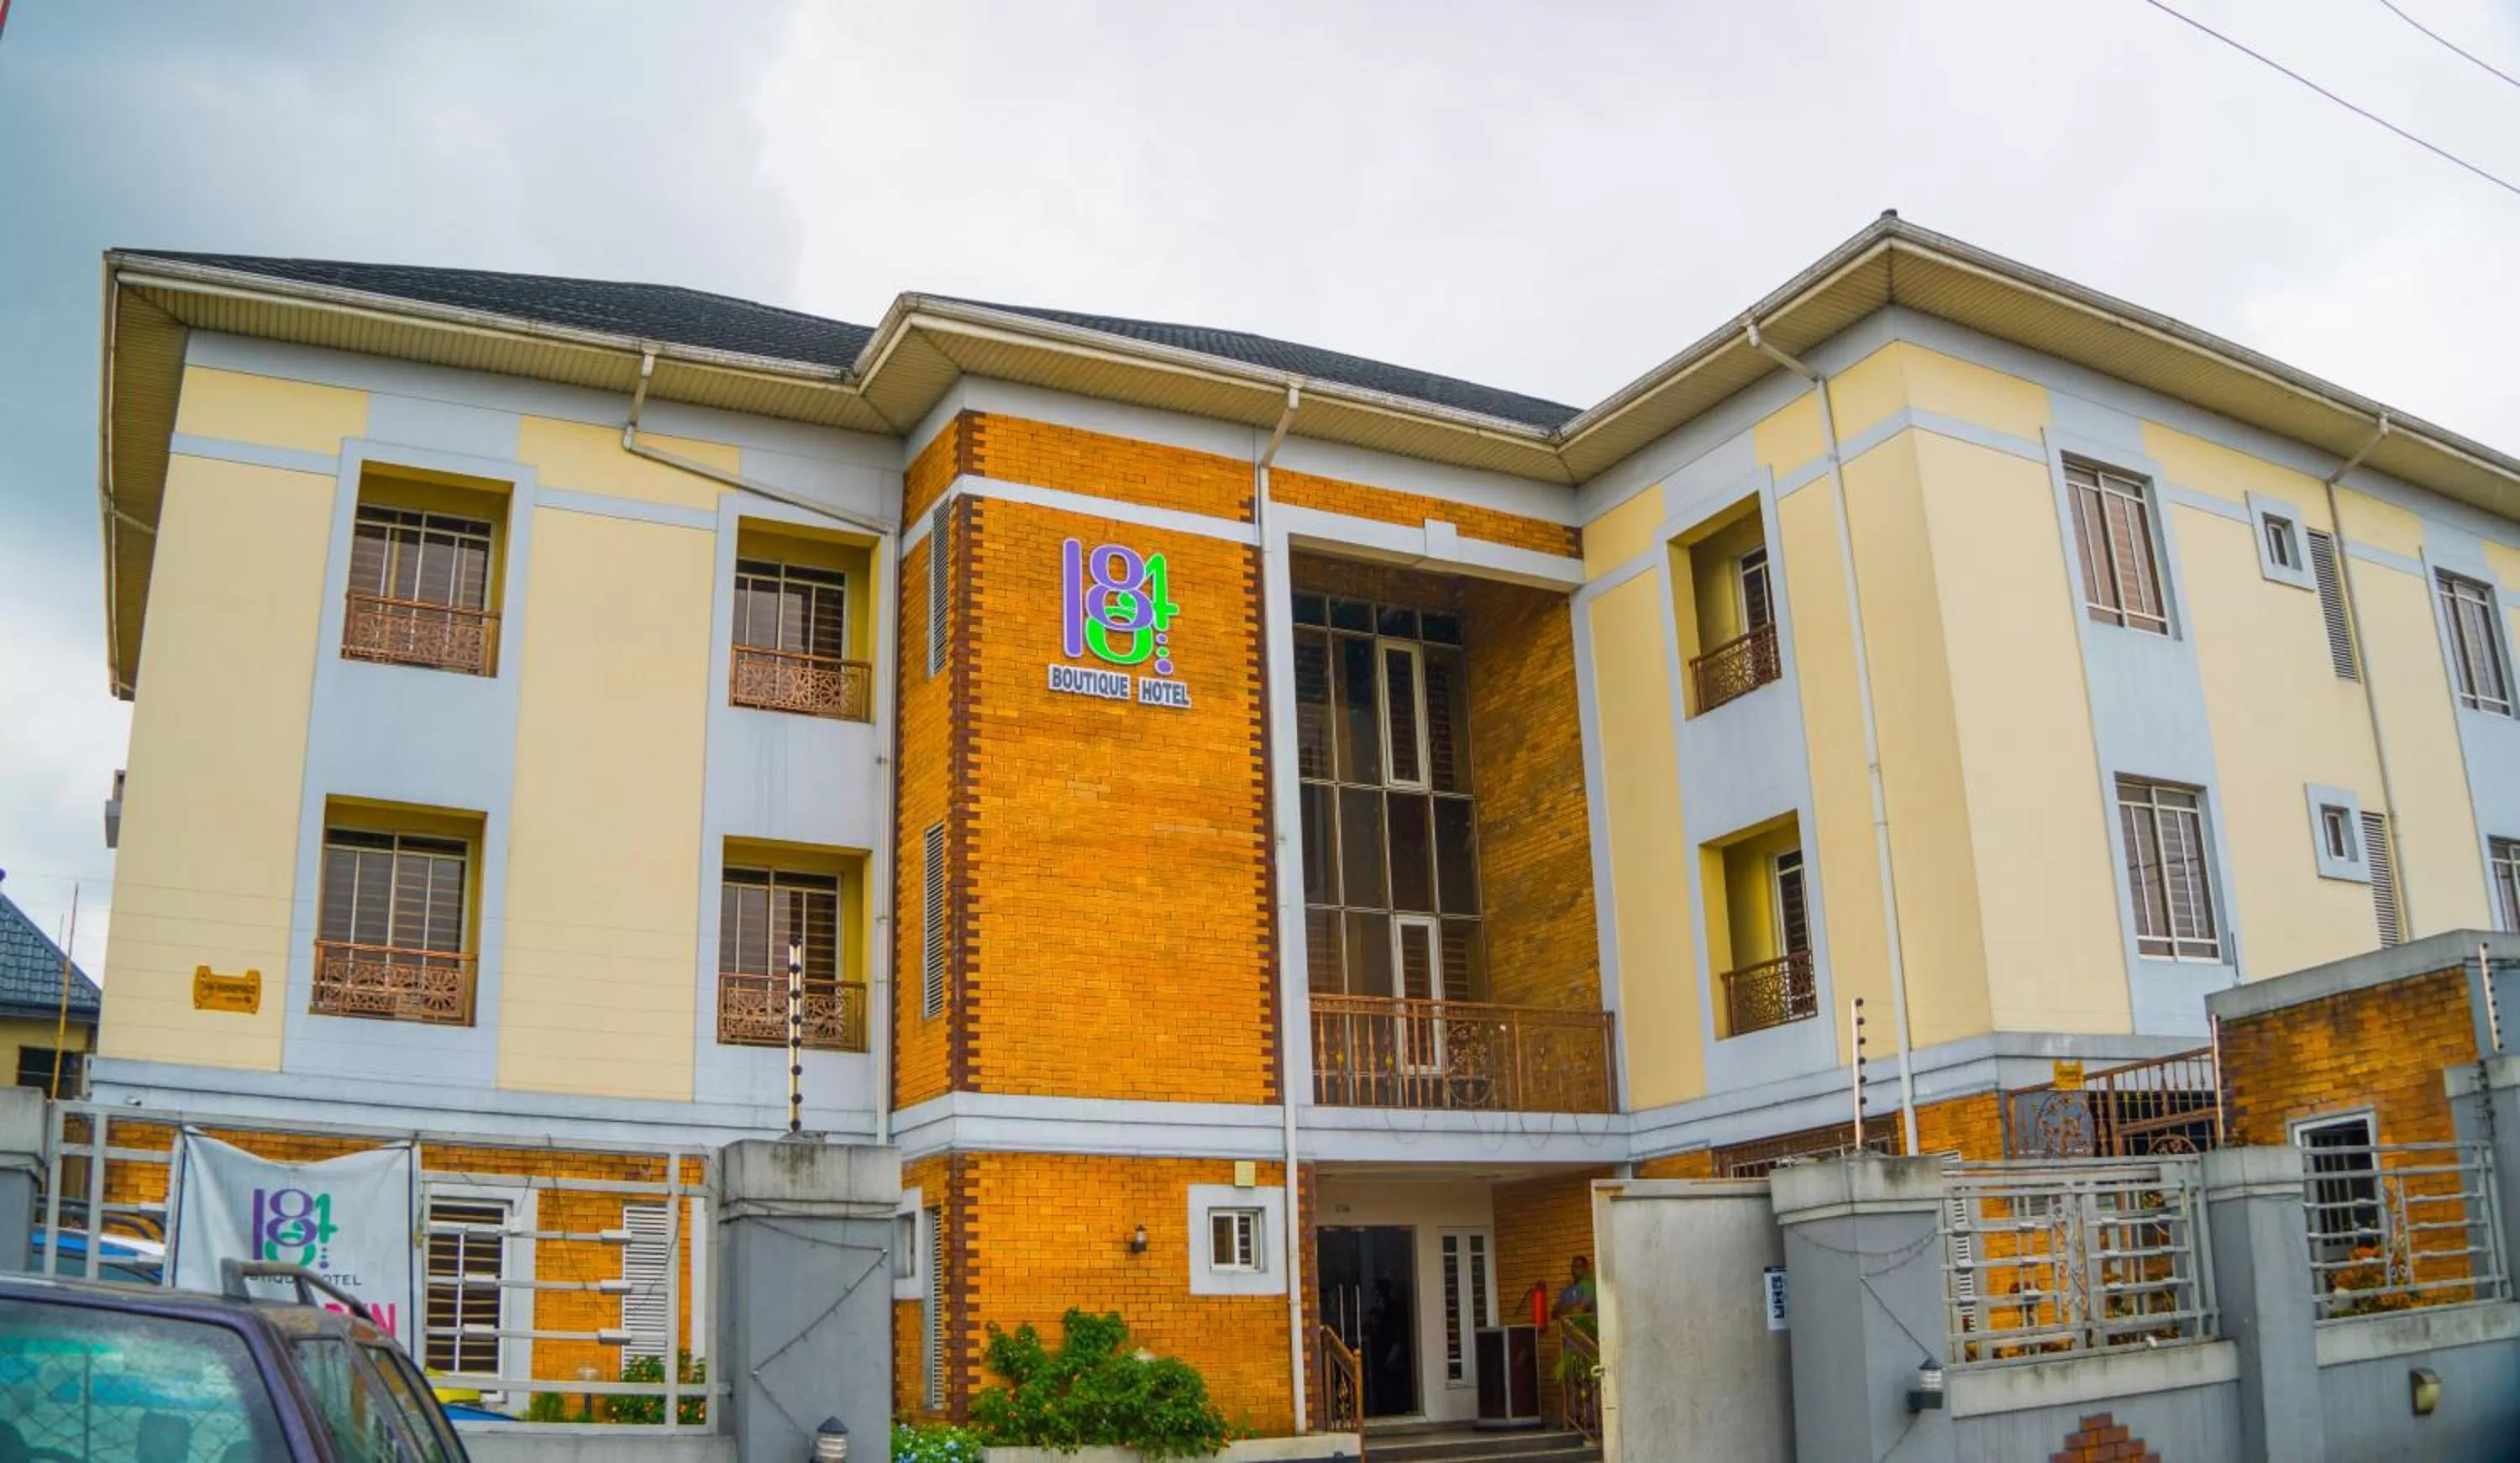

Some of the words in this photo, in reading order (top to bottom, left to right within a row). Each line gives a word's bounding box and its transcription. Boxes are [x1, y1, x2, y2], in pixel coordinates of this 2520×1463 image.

[1053, 667, 1128, 697] BOUTIQUE
[1142, 679, 1189, 705] HOTEL
[322, 1274, 363, 1286] OTEL
